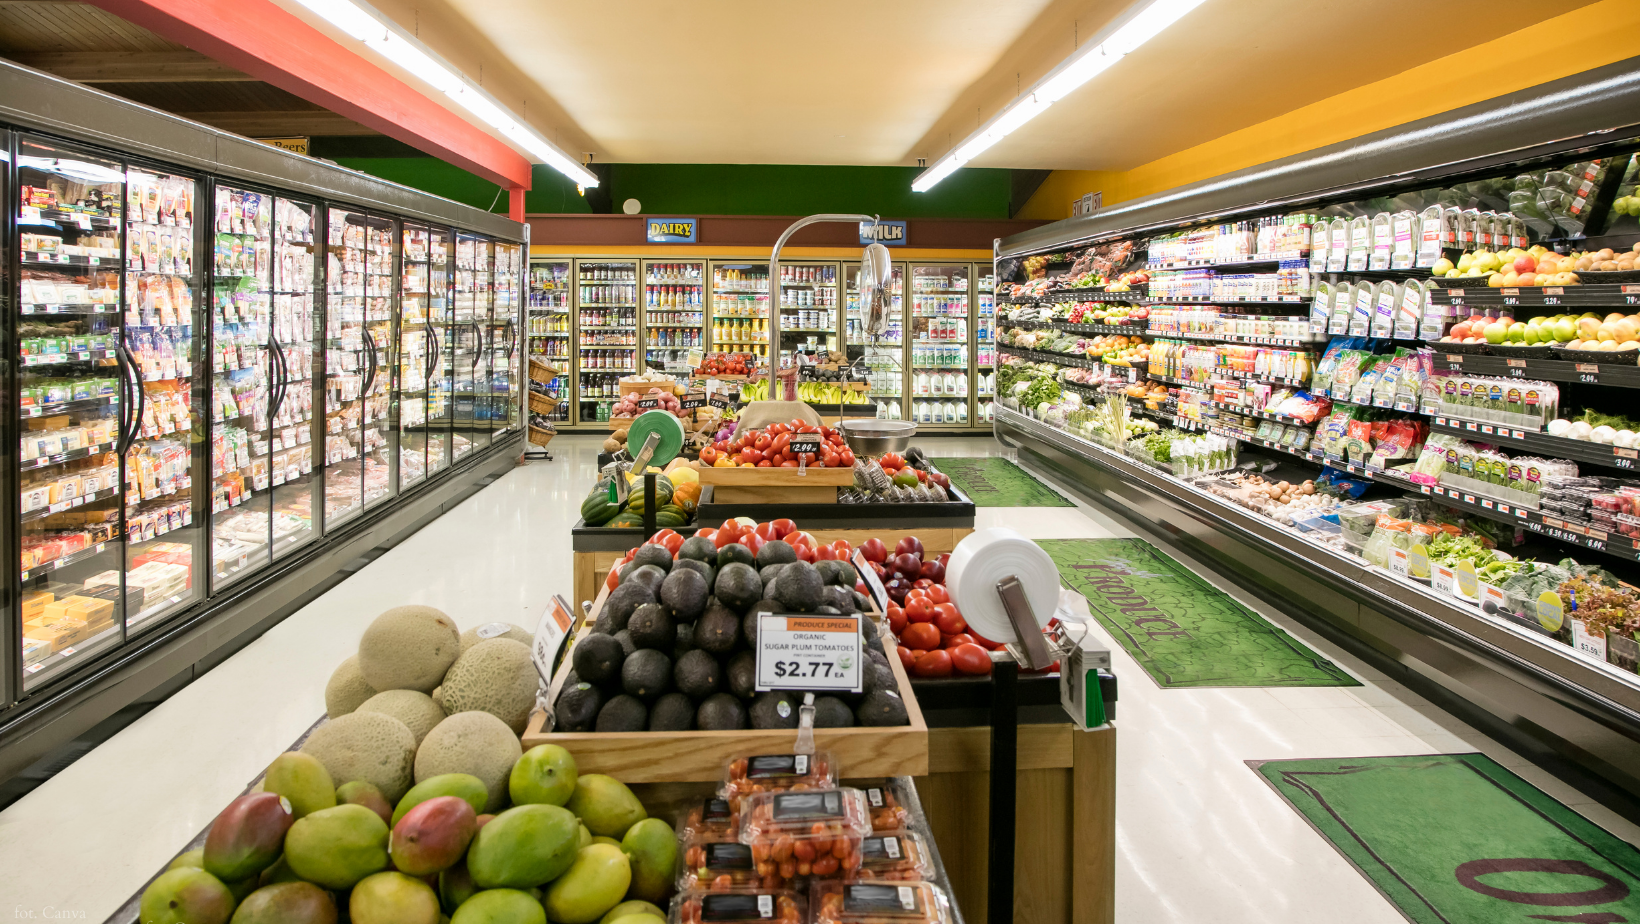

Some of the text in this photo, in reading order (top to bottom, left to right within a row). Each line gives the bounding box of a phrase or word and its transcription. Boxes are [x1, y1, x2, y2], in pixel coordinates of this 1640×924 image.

[650, 223, 692, 238] DAIRY
[862, 224, 903, 240] MILK
[1538, 607, 1562, 622] LOCAL
[814, 644, 854, 652] TOMATOES
[774, 660, 834, 679] $2.77
